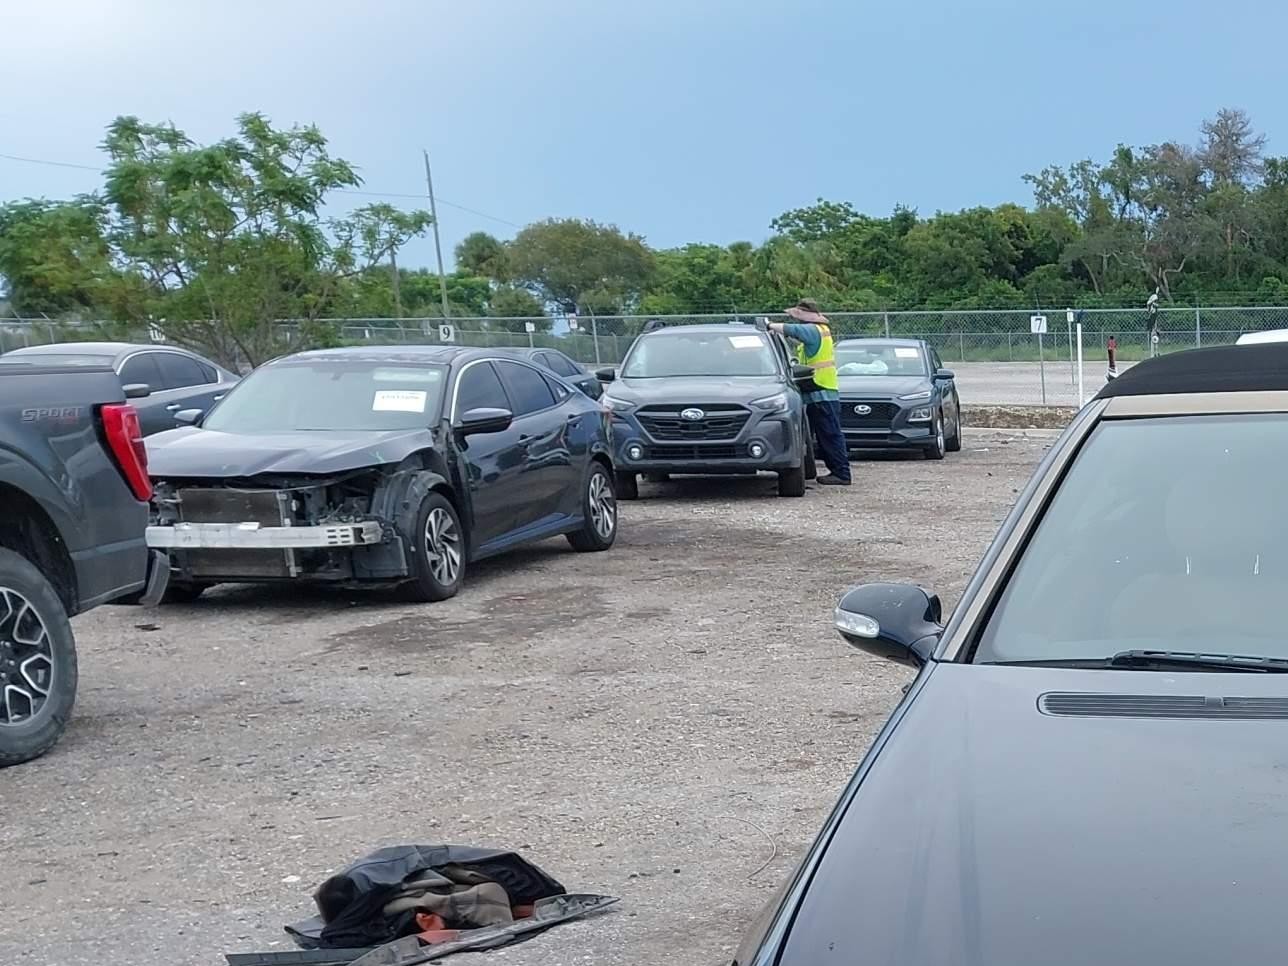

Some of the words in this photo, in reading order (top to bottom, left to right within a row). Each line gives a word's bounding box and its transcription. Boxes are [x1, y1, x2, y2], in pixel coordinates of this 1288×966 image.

[1034, 317, 1043, 332] 7
[442, 326, 451, 340] 9
[22, 406, 84, 422] SPORT
